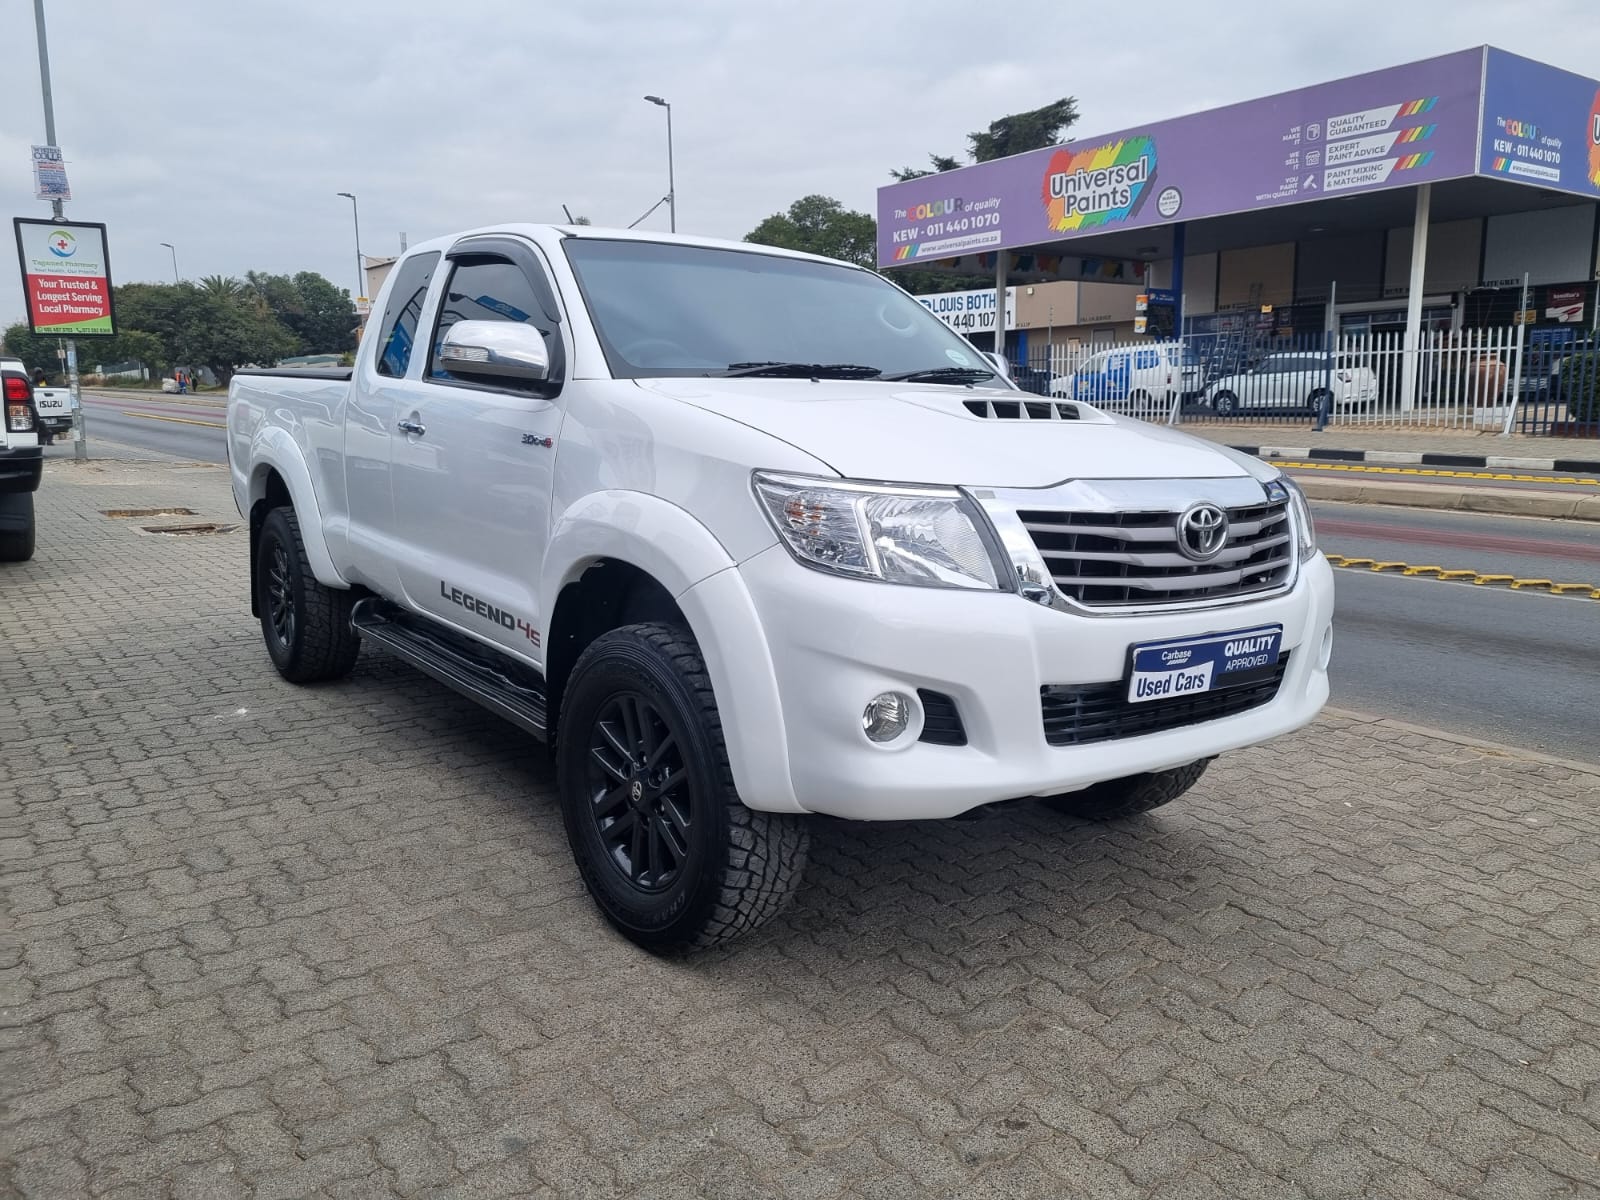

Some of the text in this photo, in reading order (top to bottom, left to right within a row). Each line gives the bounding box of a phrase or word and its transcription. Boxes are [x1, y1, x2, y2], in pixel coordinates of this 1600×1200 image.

[1290, 126, 1301, 134] WE
[1329, 119, 1387, 136] GUARANTEED
[1330, 115, 1366, 128] QUALITY
[1505, 118, 1542, 142] COLOUR
[1328, 142, 1361, 154] EXPERT
[1328, 145, 1386, 162] PAINT ADVICE
[1494, 139, 1513, 154] KEW
[1517, 144, 1529, 158] 011
[1529, 147, 1543, 161] 440
[1544, 150, 1561, 164] 1070
[1051, 157, 1147, 197] Universal
[1327, 164, 1383, 180] PAINT MIXING
[1333, 174, 1378, 187] MATCHING
[894, 197, 1001, 222] The COLOUR of quality
[1066, 187, 1129, 215] Paints
[893, 227, 919, 243] KEW
[926, 222, 944, 236] 011
[946, 218, 969, 233] 440
[971, 212, 1000, 229] 1070
[921, 236, 998, 253] www.universalpaints.co.za
[38, 279, 98, 290] Your Trusted &
[37, 290, 103, 304] Longest Serving
[932, 293, 996, 313] LOUIS BOTH
[39, 303, 104, 316] Local Pharmacy
[953, 313, 975, 329] 440
[40, 400, 62, 408] ISUZU
[1224, 635, 1276, 657] QUALITY
[1161, 649, 1192, 661] Carbase
[1225, 654, 1268, 671] APPROVED
[1136, 672, 1206, 698] Used Cars
